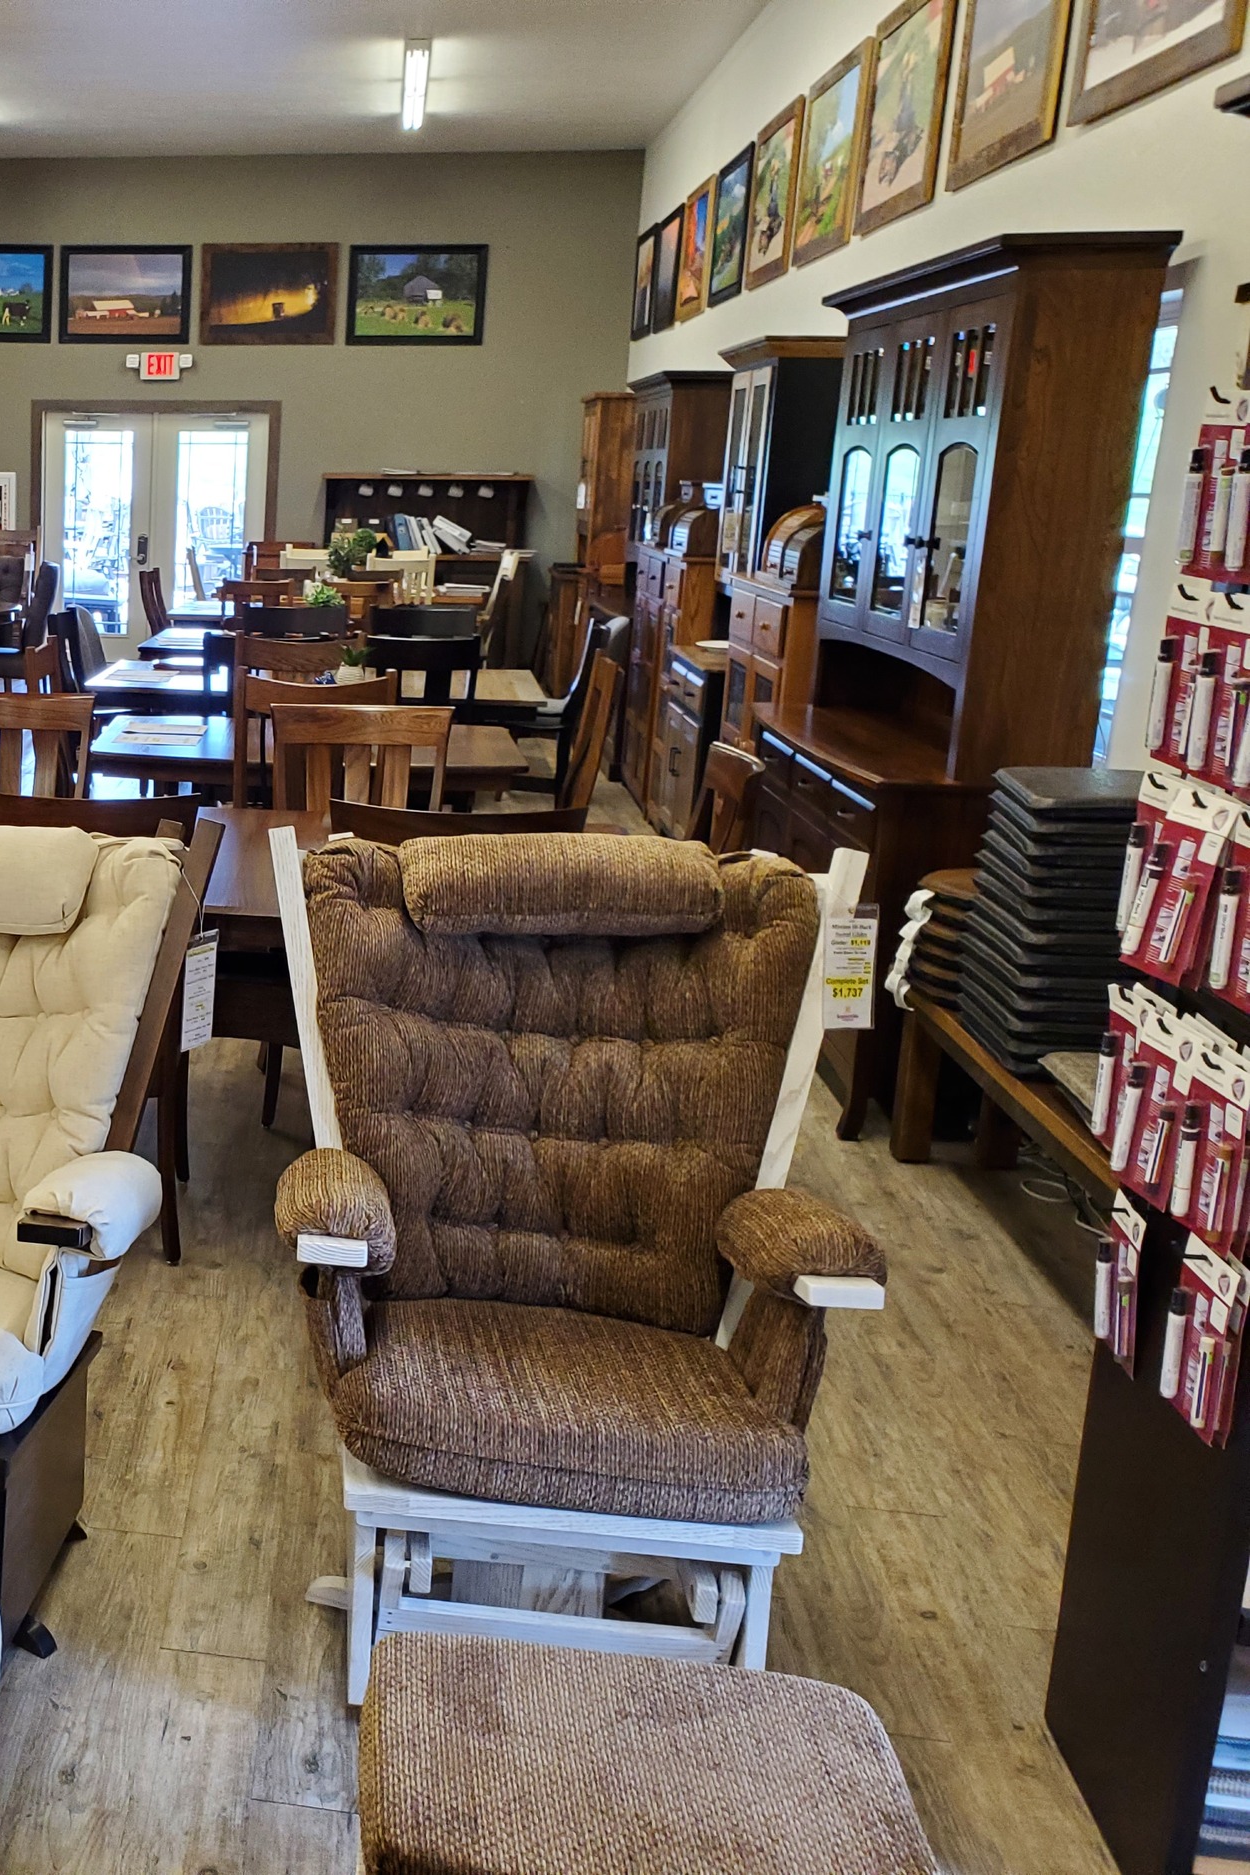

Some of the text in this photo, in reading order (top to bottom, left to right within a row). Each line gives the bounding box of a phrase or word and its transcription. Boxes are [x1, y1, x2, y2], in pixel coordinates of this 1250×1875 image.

[147, 354, 174, 375] EXIT
[825, 977, 856, 985] Complete
[832, 987, 863, 998] $1,737
